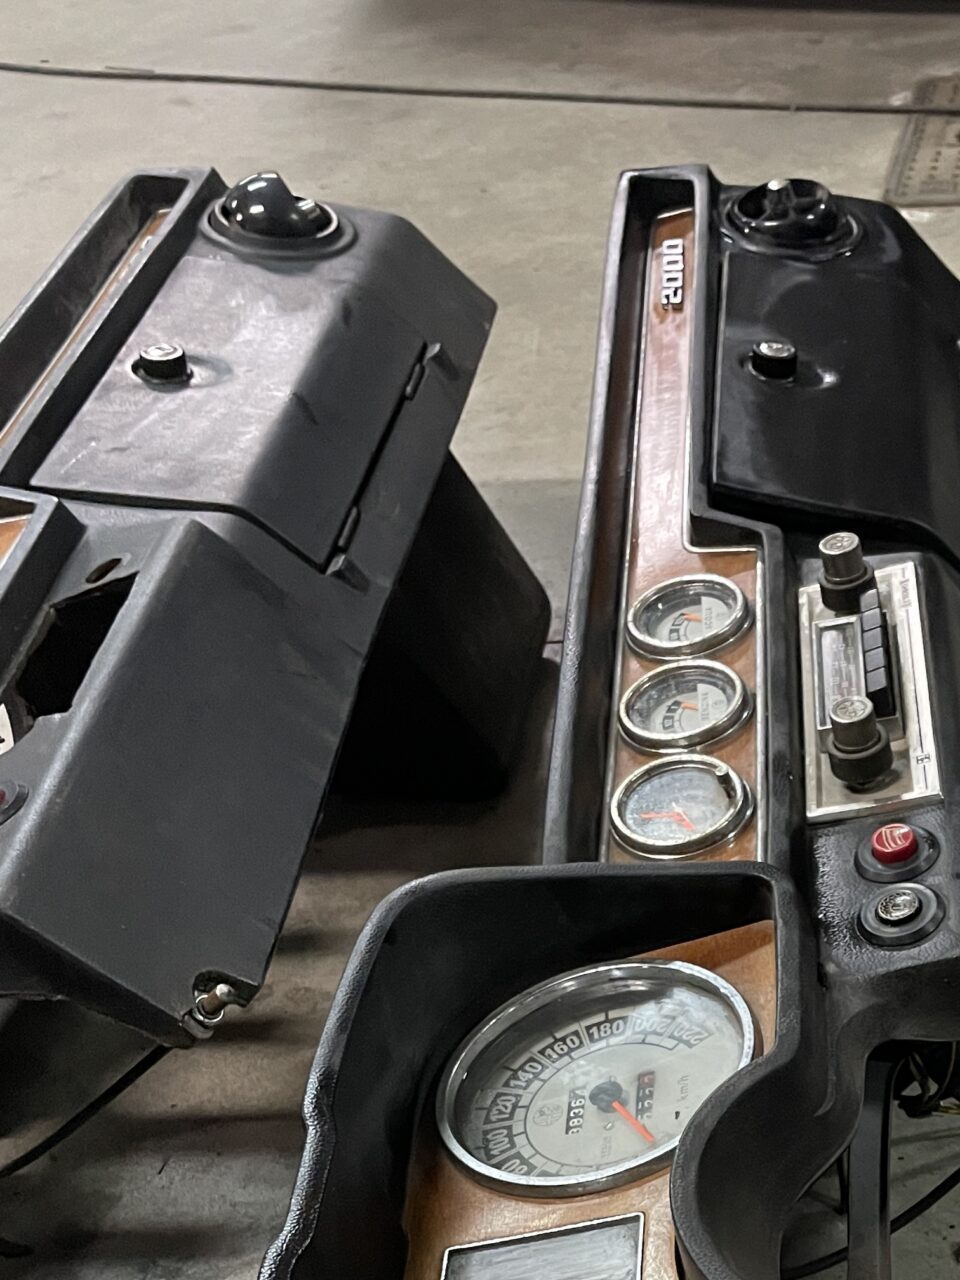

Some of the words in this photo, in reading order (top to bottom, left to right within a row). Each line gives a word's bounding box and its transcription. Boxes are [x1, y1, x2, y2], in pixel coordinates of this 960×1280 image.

[661, 238, 684, 304] 2000
[588, 1019, 625, 1040] 180
[545, 1035, 581, 1060] 160
[510, 1061, 543, 1089] 140
[490, 1095, 517, 1122] 120
[486, 1128, 511, 1156] 100
